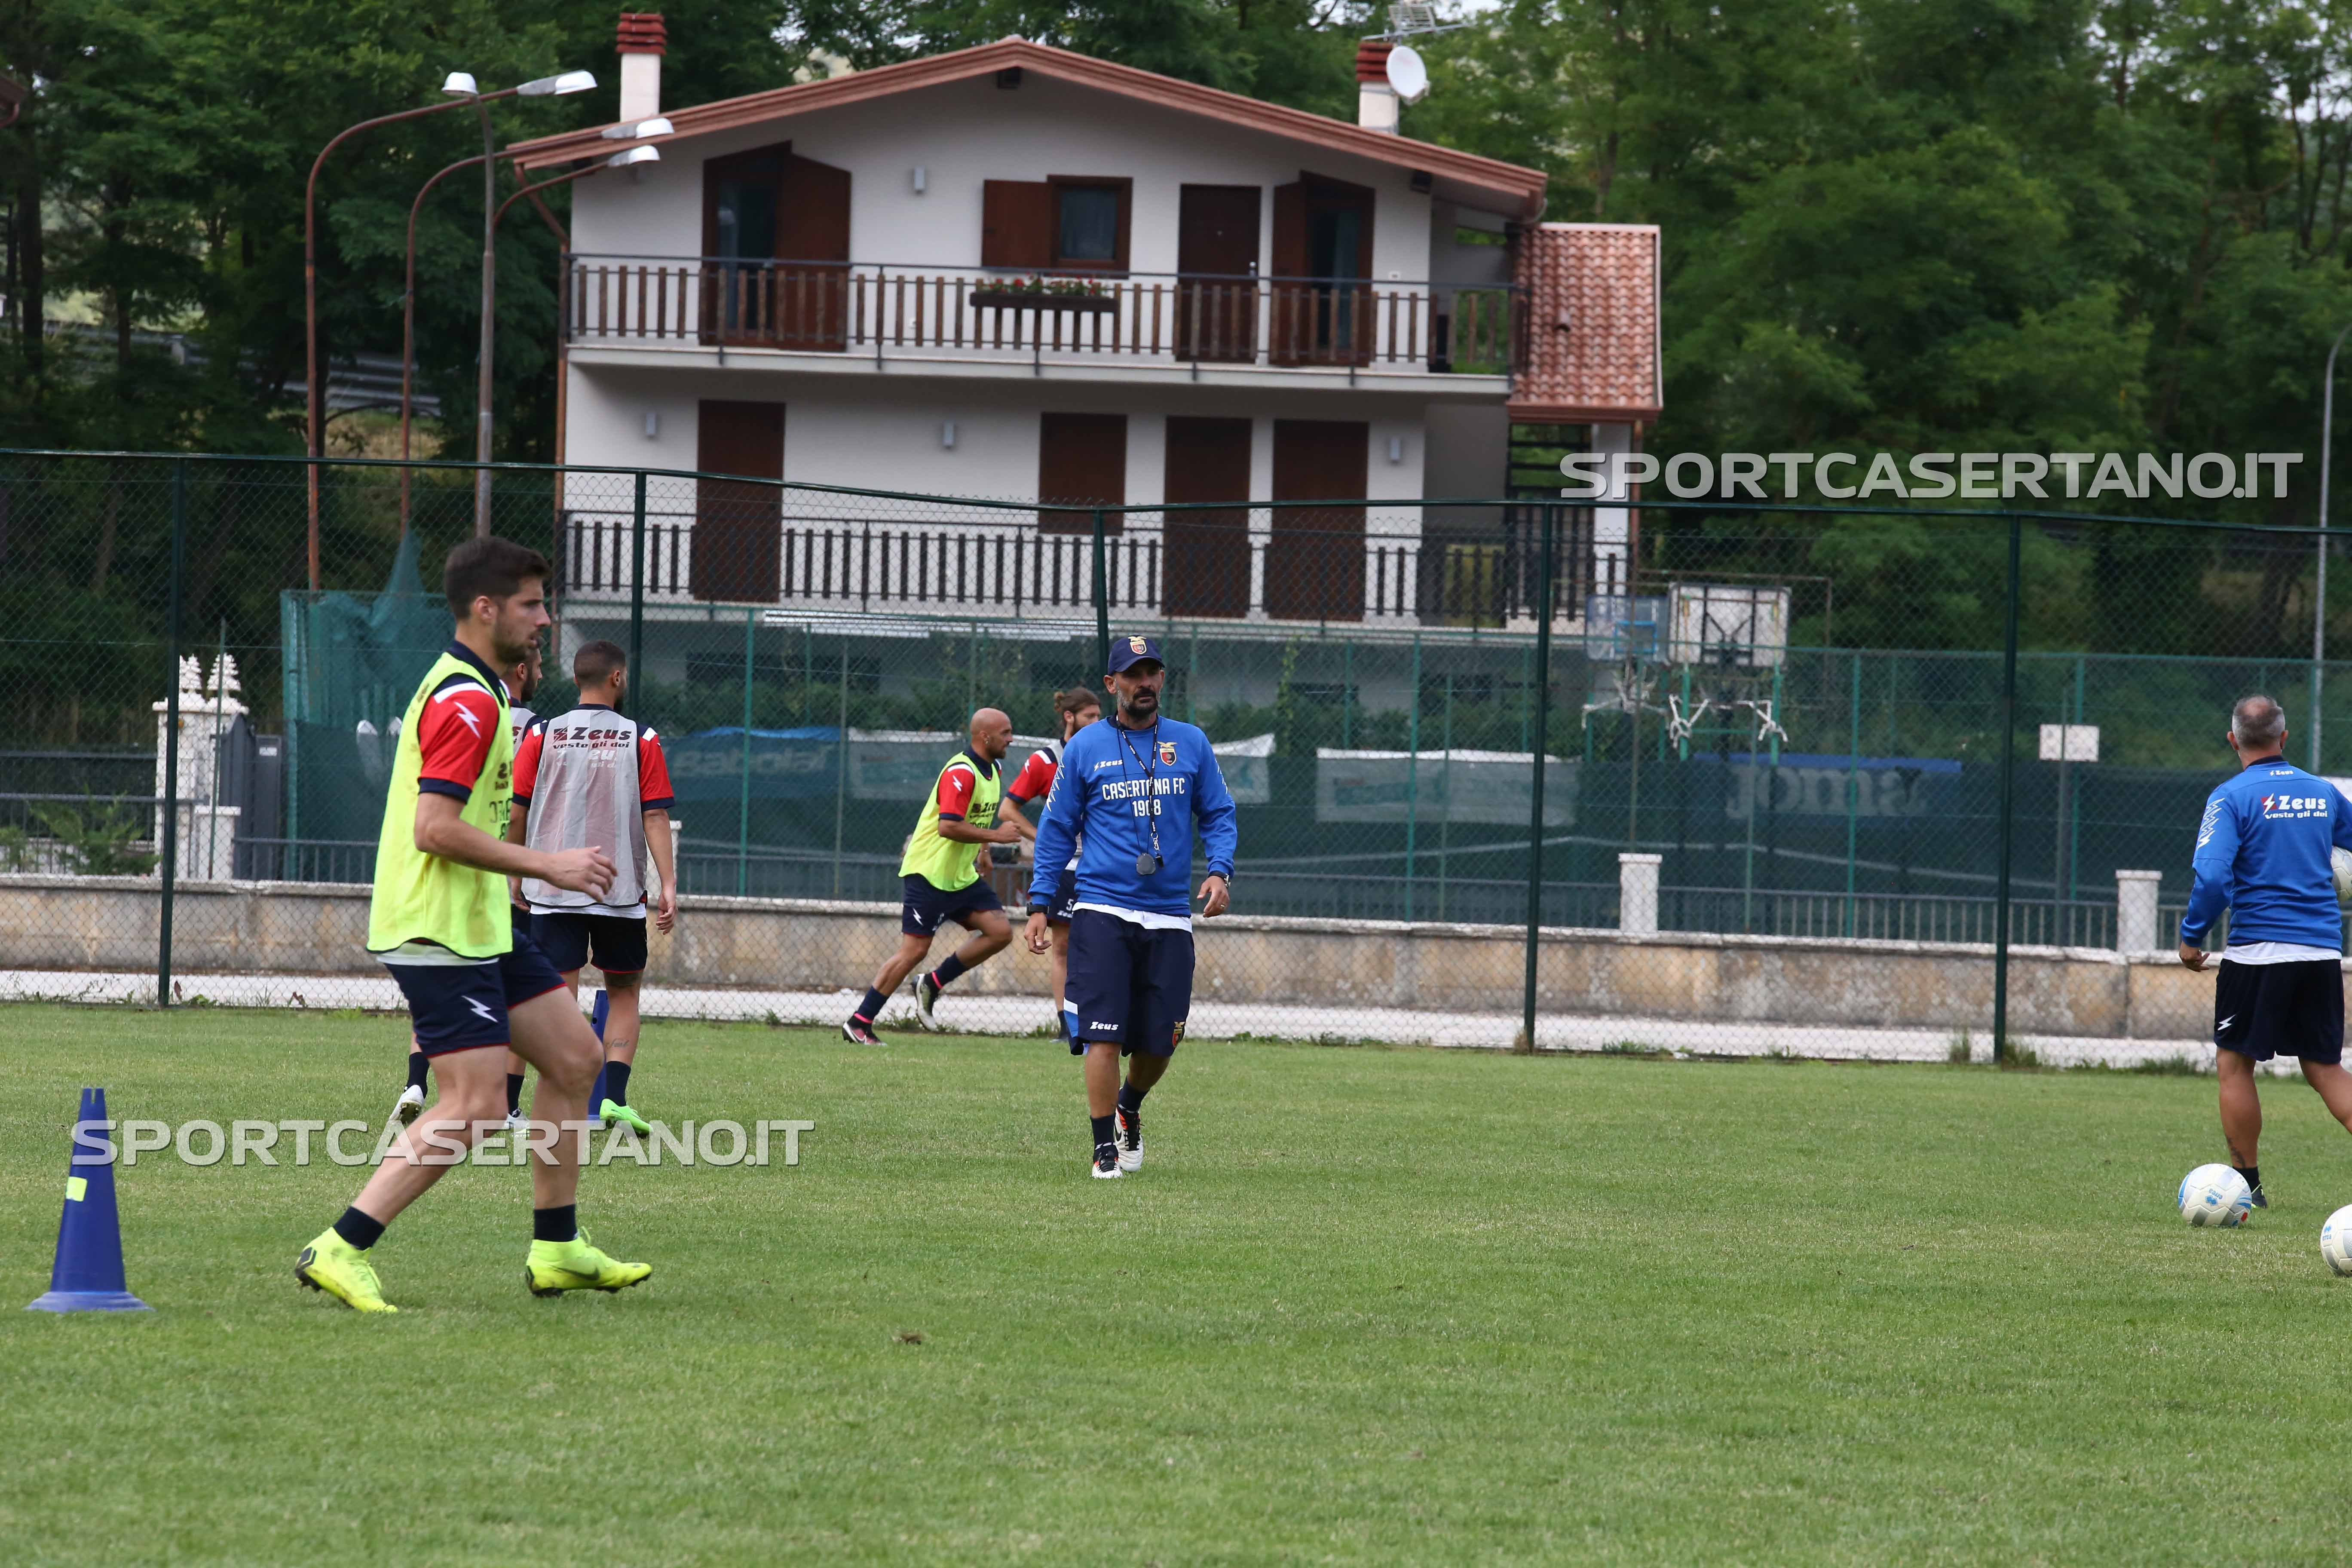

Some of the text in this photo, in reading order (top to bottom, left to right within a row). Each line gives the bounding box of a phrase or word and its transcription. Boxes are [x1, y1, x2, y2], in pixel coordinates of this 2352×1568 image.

[570, 727, 632, 740] Zeus
[1100, 760, 1123, 768] Zeus
[1173, 778, 1185, 794] FC
[2278, 795, 2326, 810] Zeus
[2297, 810, 2310, 818] gli
[1090, 1022, 1118, 1030] Zeus
